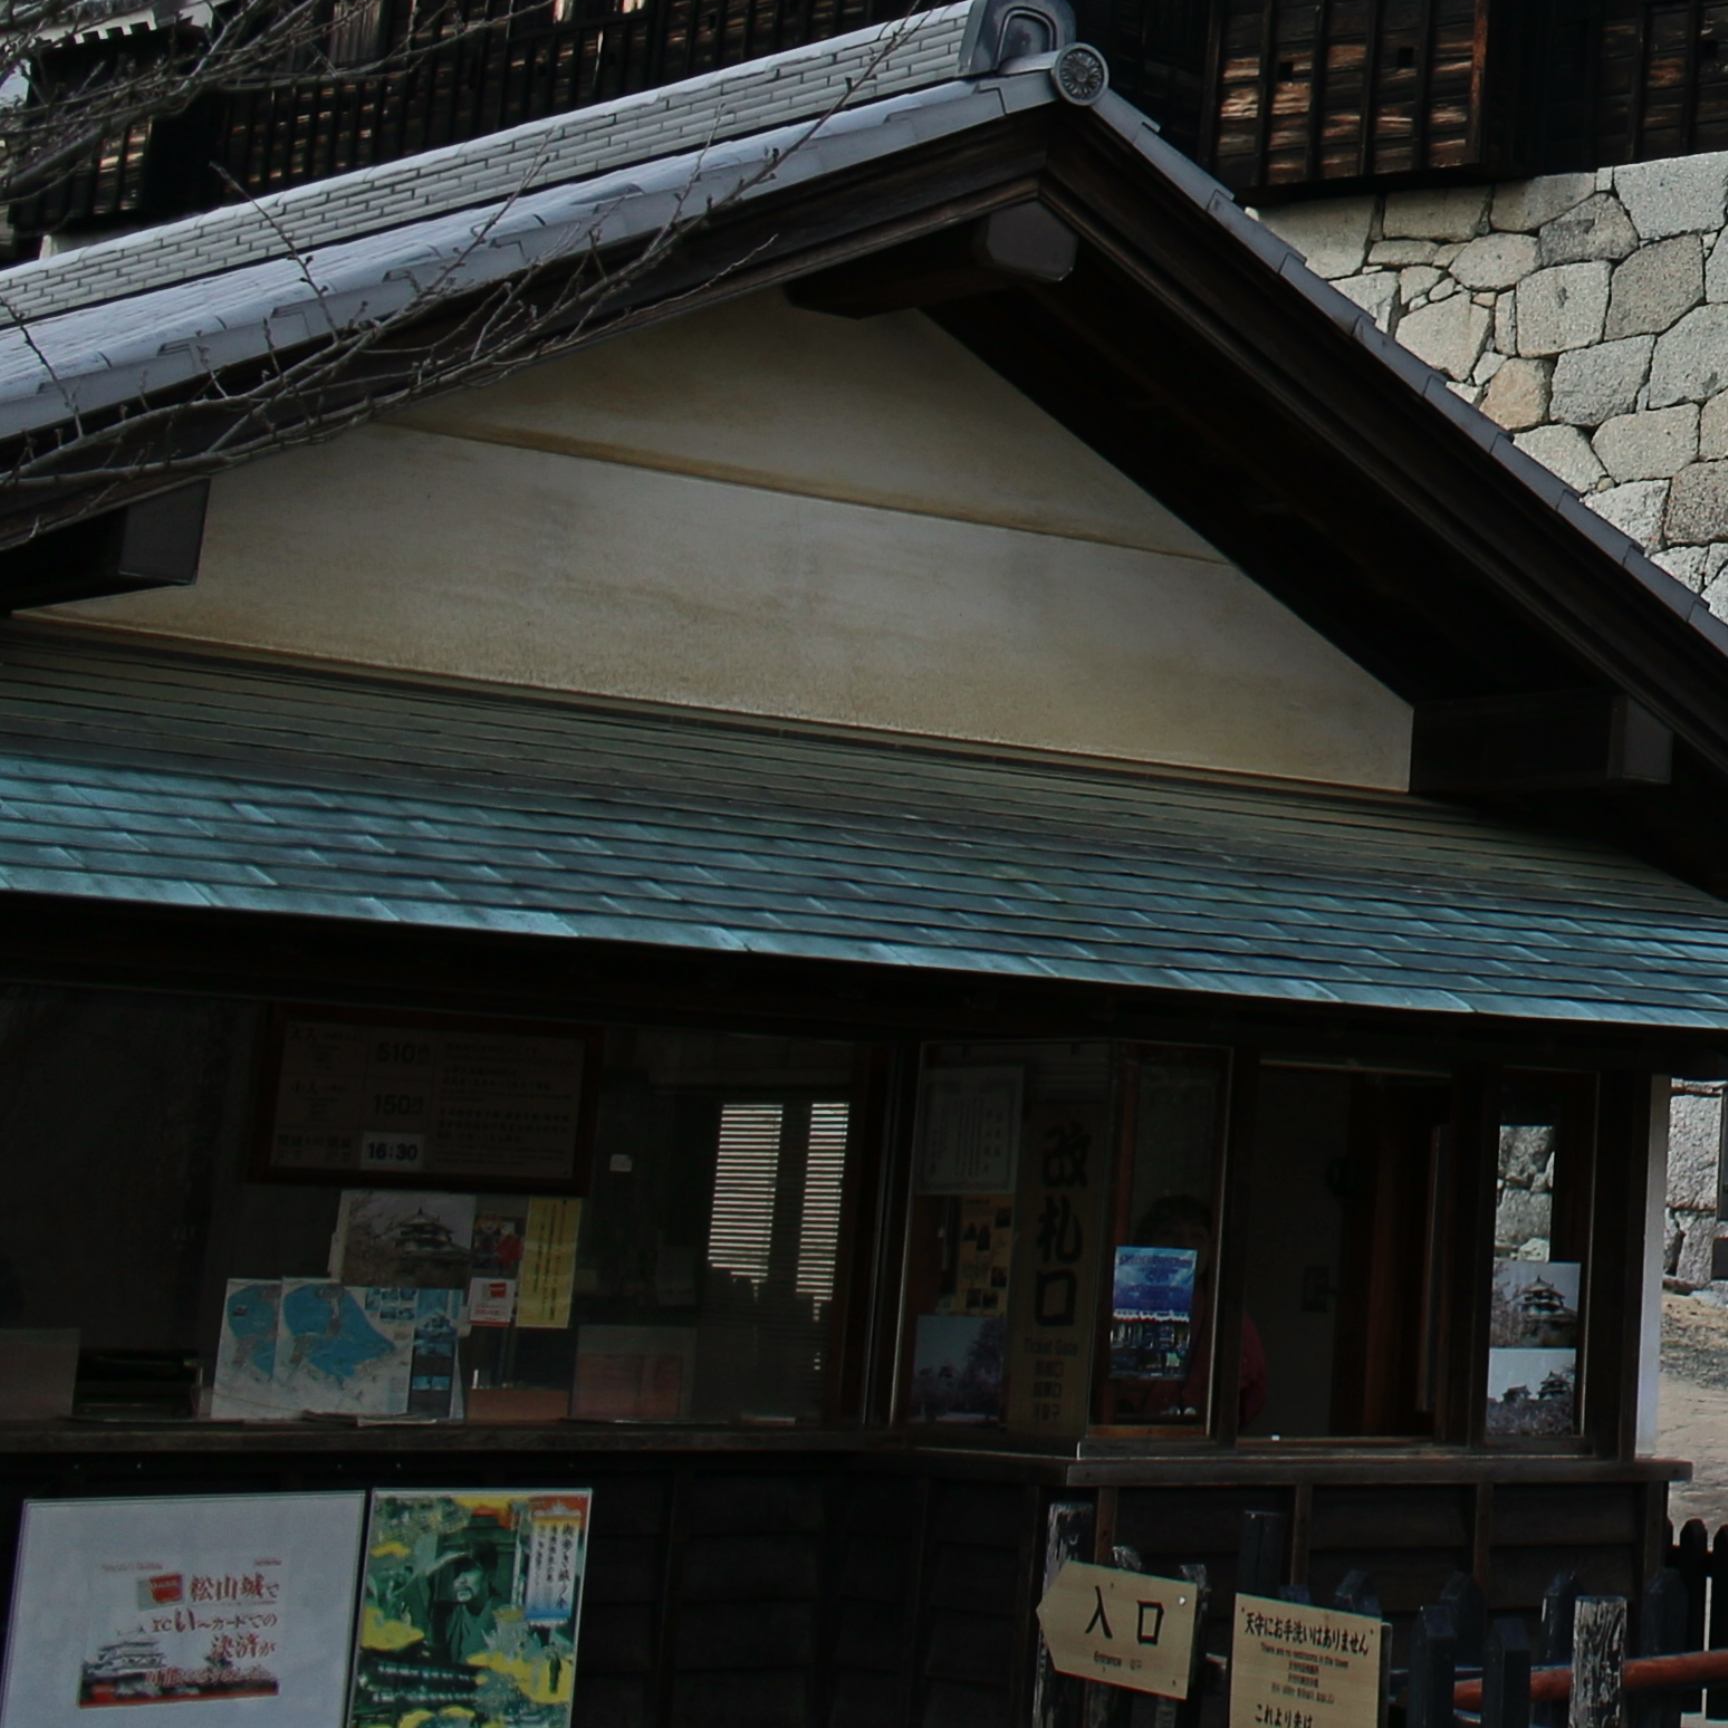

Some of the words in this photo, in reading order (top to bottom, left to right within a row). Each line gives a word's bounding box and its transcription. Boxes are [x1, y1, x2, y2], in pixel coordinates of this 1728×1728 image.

[368, 1142, 418, 1161] 16:30
[1034, 1120, 1092, 1328] 改札口
[190, 1571, 280, 1602] 松山城で
[1085, 1586, 1165, 1647] 入口
[1245, 1612, 1369, 1656] 天守にお手洗いはありません
[210, 1632, 276, 1659] 決済が
